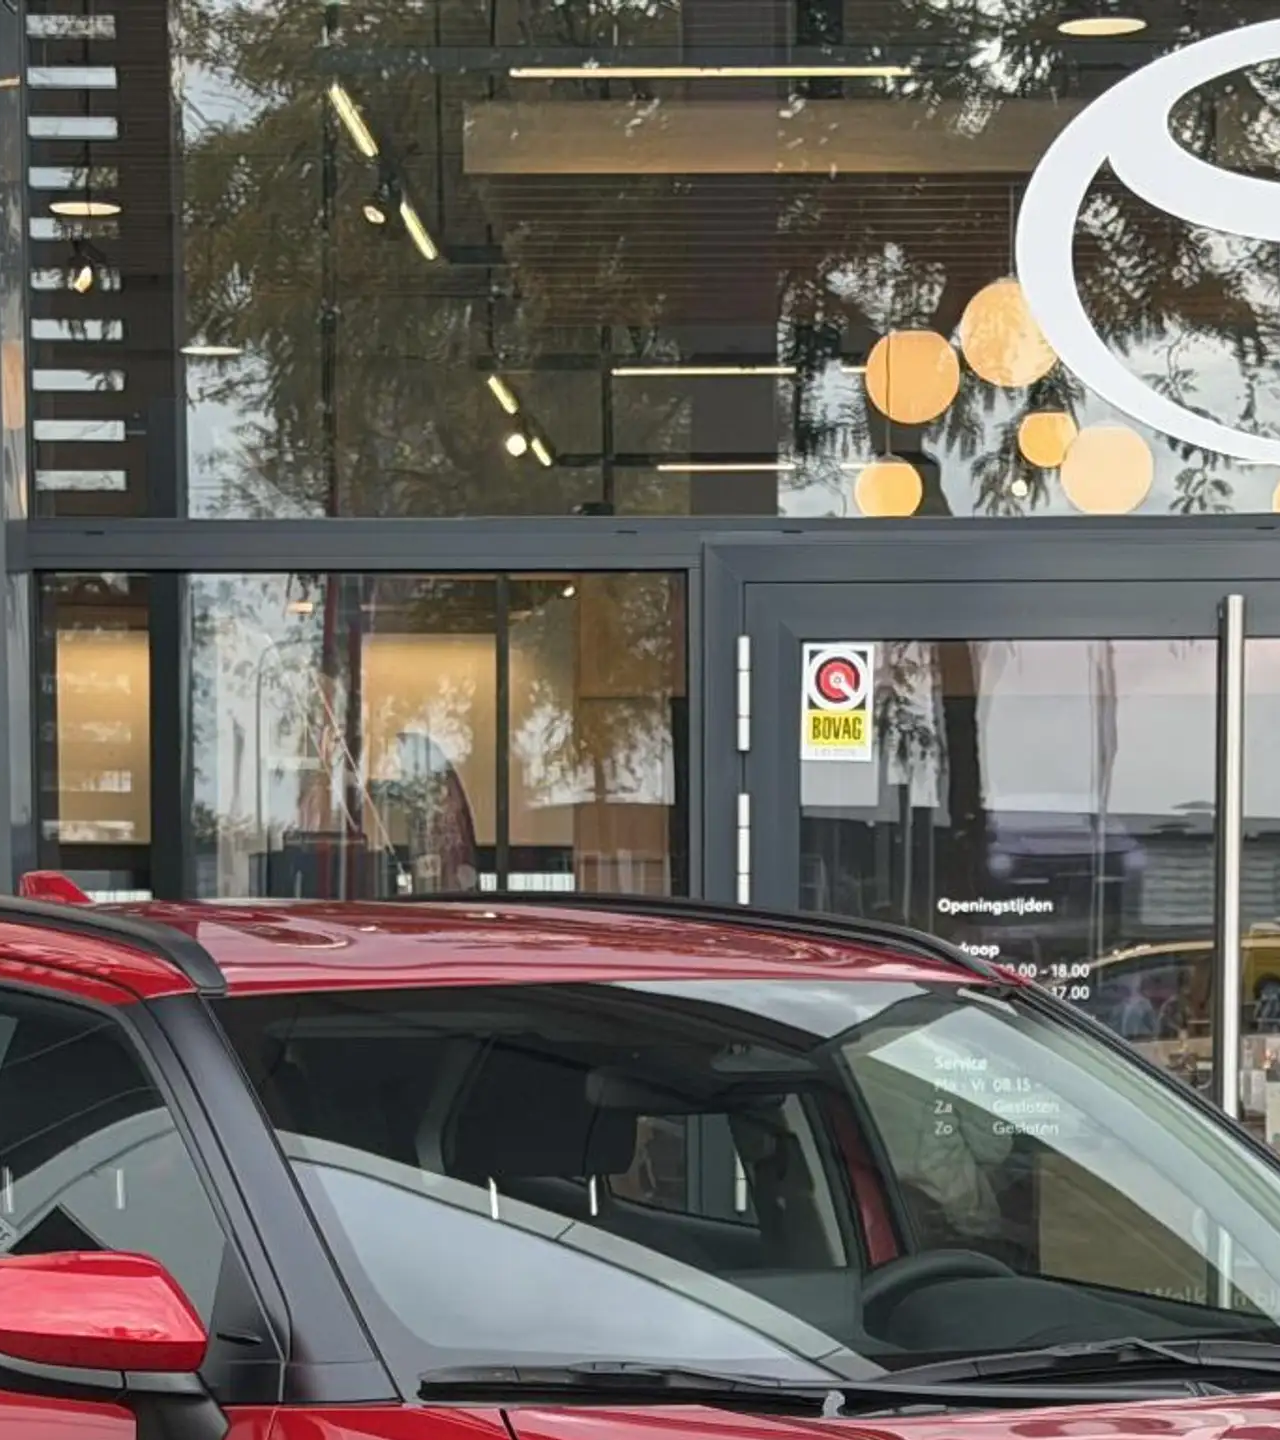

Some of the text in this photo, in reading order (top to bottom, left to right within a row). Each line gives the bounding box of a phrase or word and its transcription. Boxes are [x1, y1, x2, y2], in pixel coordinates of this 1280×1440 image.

[812, 716, 862, 740] BOVAG
[937, 896, 1053, 916] Openingstijden
[1051, 963, 1090, 978] 18.00
[1051, 985, 1090, 1000] 17.00
